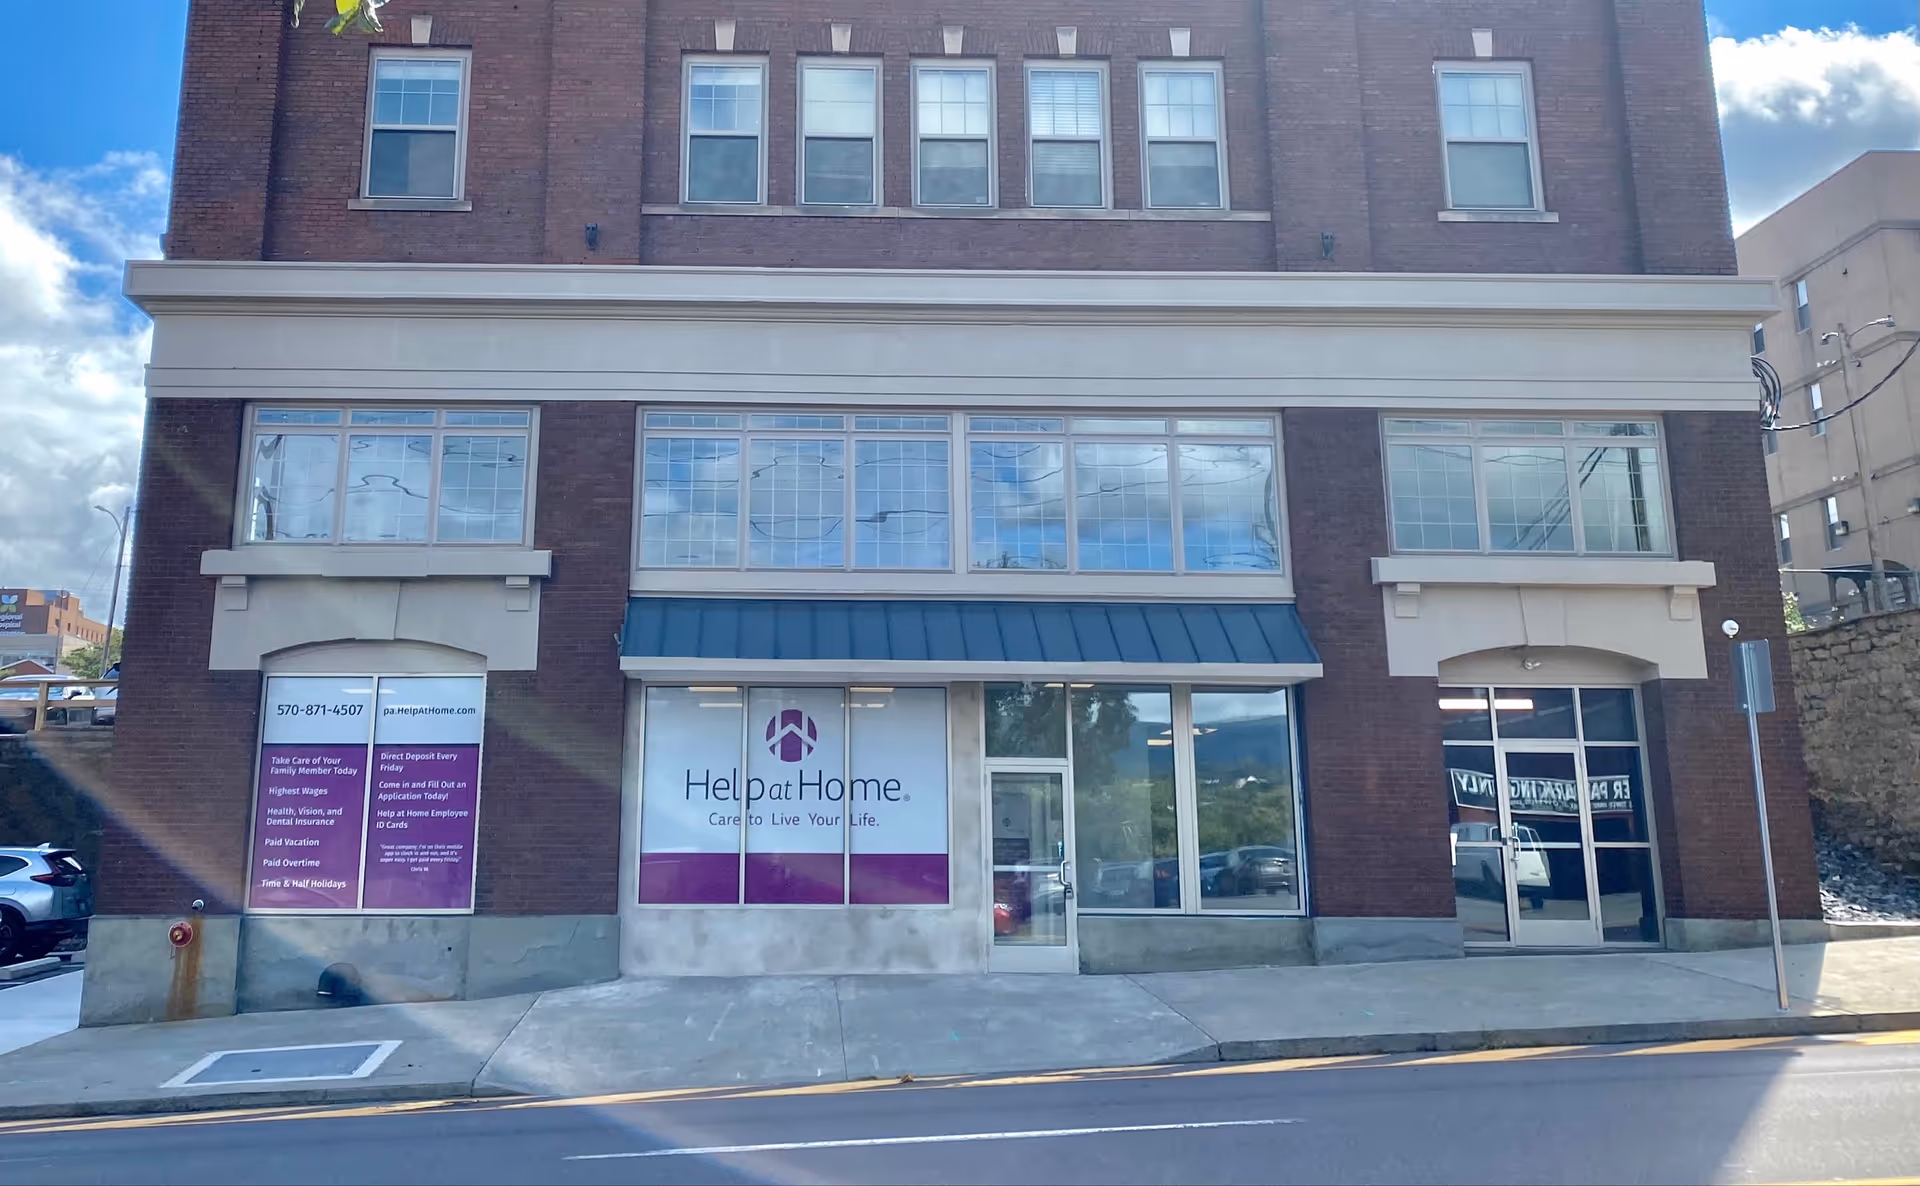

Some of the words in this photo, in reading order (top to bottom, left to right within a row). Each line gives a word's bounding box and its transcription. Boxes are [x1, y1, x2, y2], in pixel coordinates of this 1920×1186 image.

[277, 704, 364, 716] 570-871-4507
[383, 706, 476, 717] pa.HelpAtHome.com
[271, 756, 291, 765] Take
[291, 756, 310, 765] Care
[312, 756, 320, 765] of
[320, 756, 342, 765] Your
[380, 752, 404, 761] Direct
[405, 752, 435, 762] Deposit
[436, 752, 458, 762] Every
[270, 766, 297, 777] Family
[298, 766, 332, 775] Member
[333, 767, 358, 777] Today
[380, 763, 404, 773] Friday
[378, 781, 401, 789] Come
[402, 781, 410, 789] in
[411, 781, 426, 789] and
[427, 781, 439, 789] Fill
[440, 781, 455, 789] Out
[685, 767, 765, 810] Help
[769, 779, 793, 801] at
[268, 787, 300, 797] Highest
[301, 787, 328, 797] Wages
[378, 792, 422, 802] Application
[423, 792, 449, 802] Today!
[267, 807, 296, 816] Health,
[298, 807, 325, 816] Vision,
[326, 807, 343, 816] and
[377, 809, 395, 819] Help
[396, 810, 405, 818] at
[406, 809, 429, 818] Home
[430, 809, 469, 819] Employee
[266, 817, 293, 826] Dental
[294, 817, 335, 826] Insurance
[708, 812, 741, 826] Care
[749, 814, 763, 826] to
[771, 812, 800, 826] Live
[808, 812, 840, 826] Your
[850, 813, 880, 827] Life.
[376, 821, 385, 829] ID
[386, 821, 408, 829] Cards
[264, 838, 283, 846] Paid
[284, 838, 320, 846] Vacation
[262, 858, 281, 867] Paid
[282, 858, 321, 867] Overtime
[261, 879, 282, 888] Time
[283, 879, 291, 888] &
[291, 879, 309, 888] Half
[310, 879, 347, 890] Holidays
